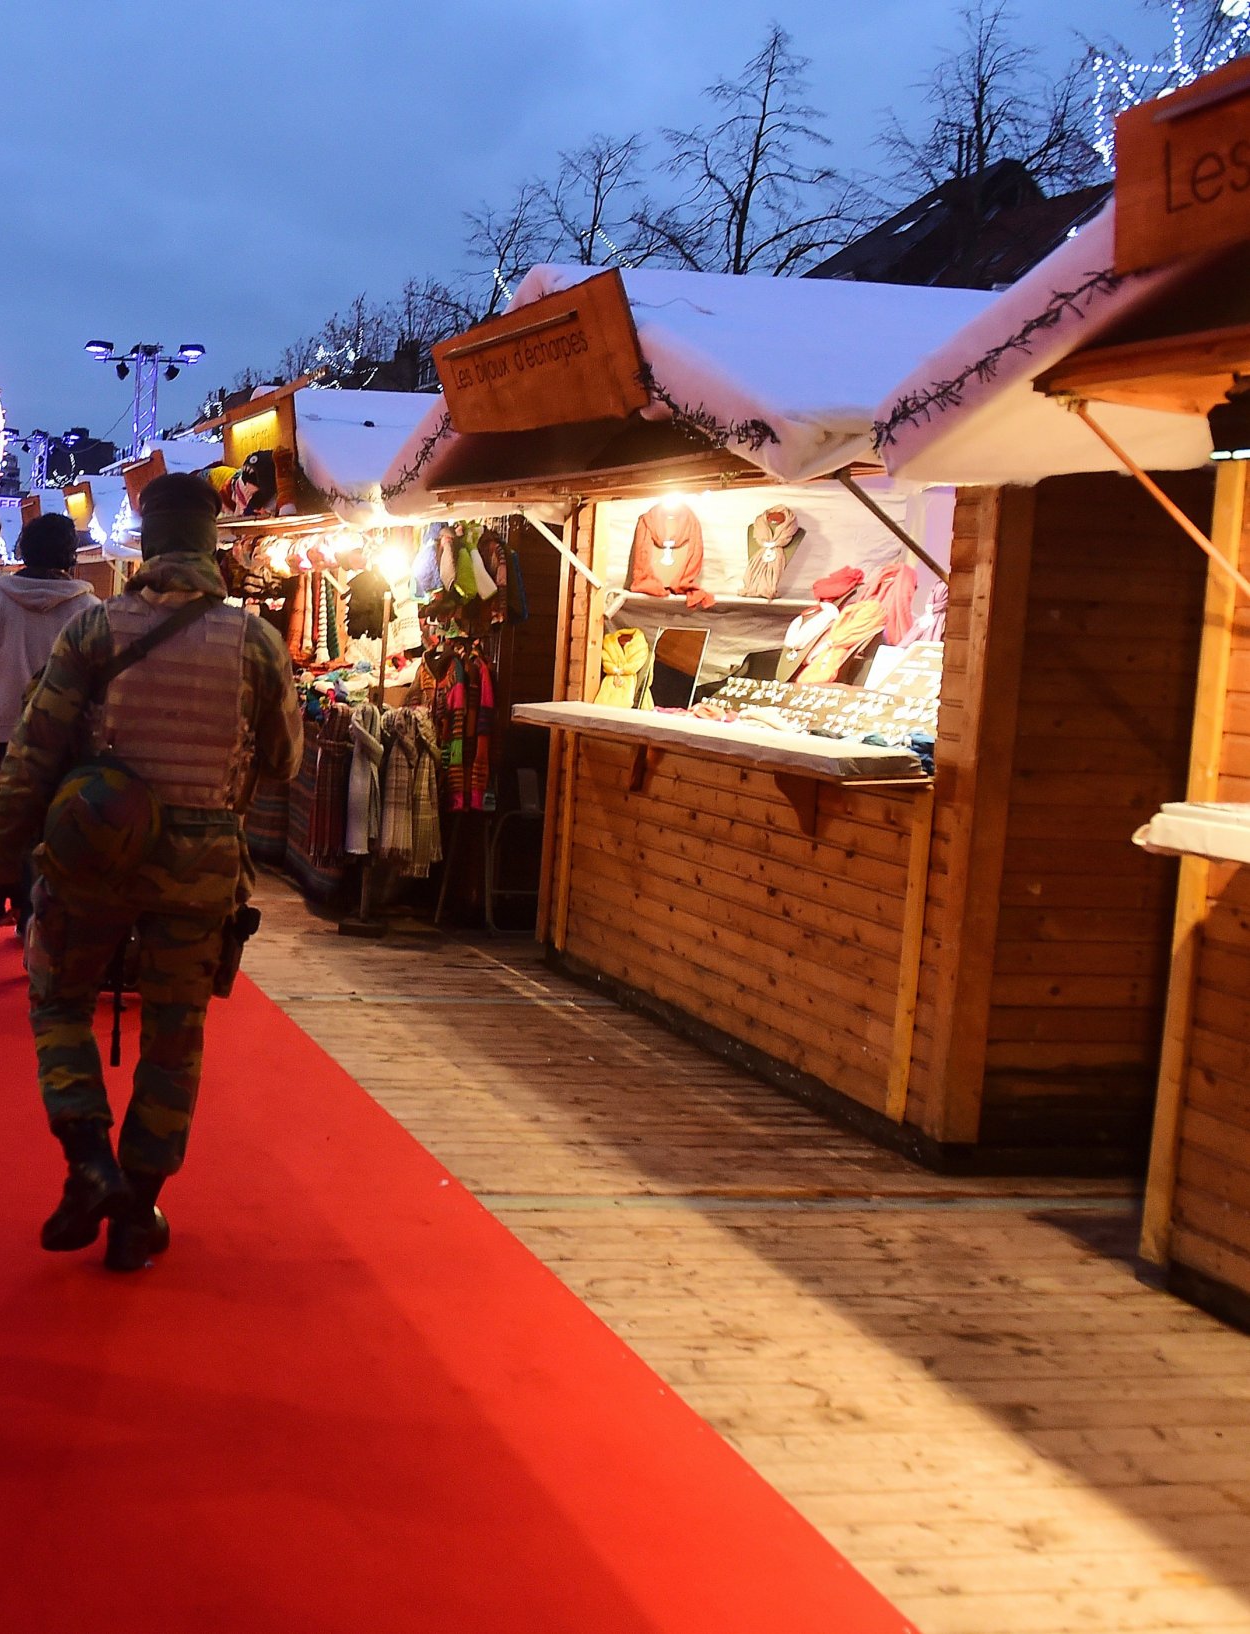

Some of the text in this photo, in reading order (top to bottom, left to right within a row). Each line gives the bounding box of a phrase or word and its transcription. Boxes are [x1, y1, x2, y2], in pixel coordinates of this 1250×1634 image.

[1163, 140, 1250, 214] Les
[451, 329, 589, 391] Les bijoux d'écharpes
